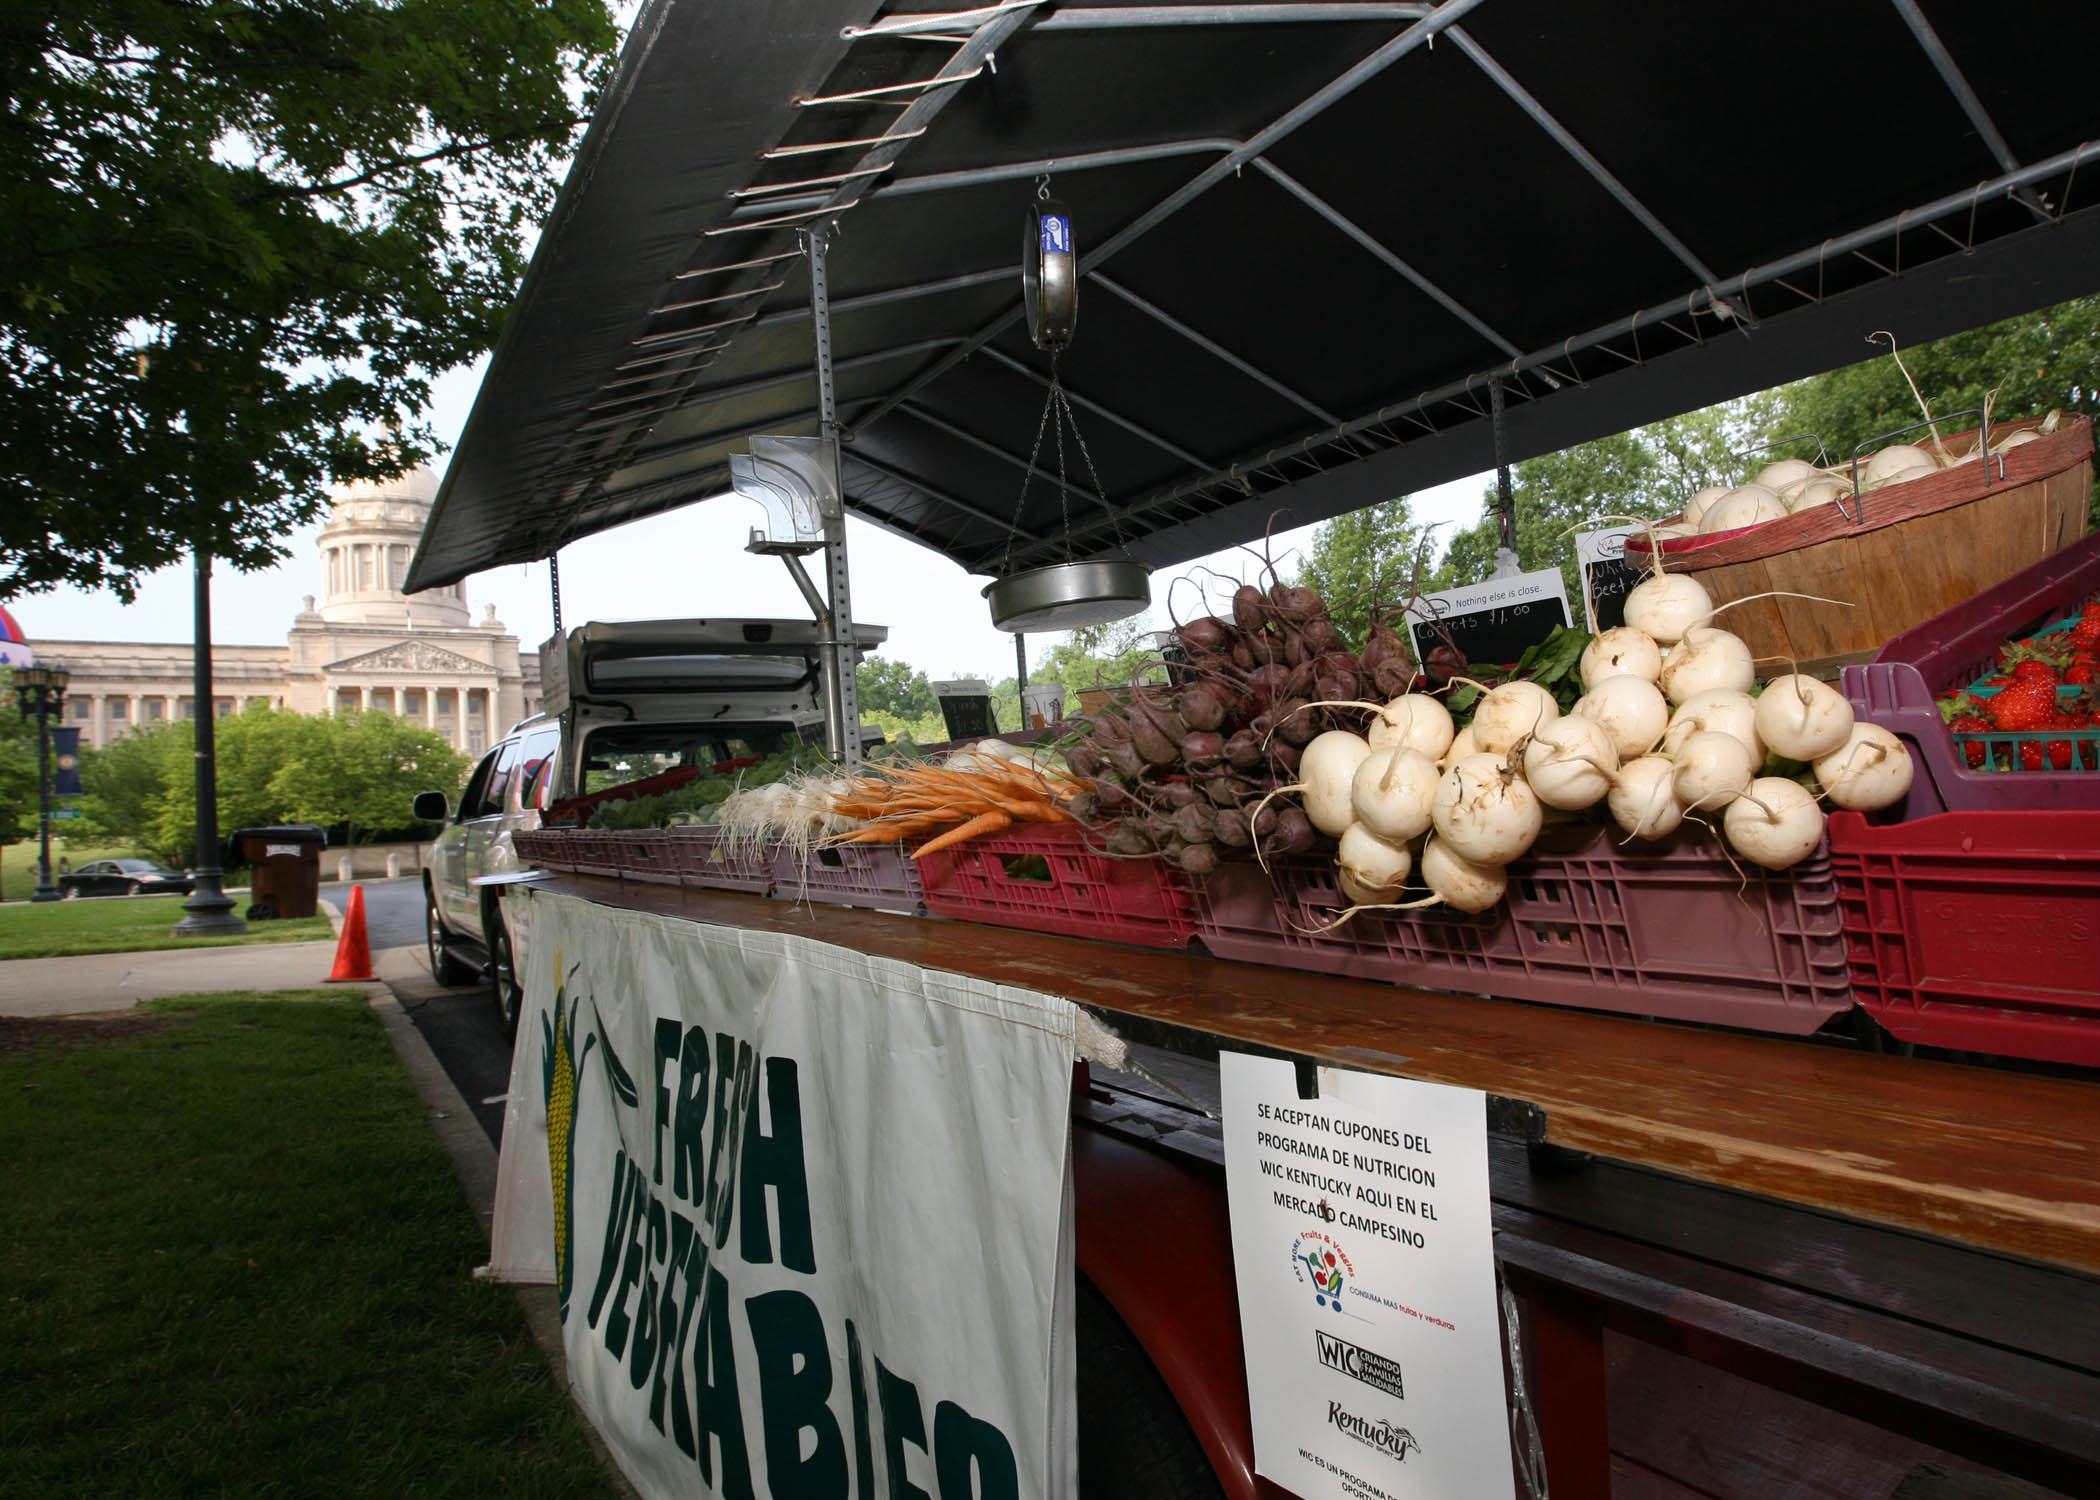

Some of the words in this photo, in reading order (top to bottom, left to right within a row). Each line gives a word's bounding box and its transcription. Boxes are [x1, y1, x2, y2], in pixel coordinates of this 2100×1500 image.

[1456, 595, 1487, 608] Nothing
[1490, 591, 1506, 601] else
[1509, 589, 1515, 598] is
[1518, 586, 1542, 597] close.
[1257, 1103, 1271, 1119] SE
[1274, 1107, 1330, 1132] ACEPTAN
[1334, 1119, 1400, 1147] CUPONES
[1404, 1133, 1432, 1154] DEL
[1257, 1131, 1329, 1162] PROGRAMA
[1333, 1149, 1350, 1168] DE
[1354, 1154, 1435, 1188] NUTRICION
[1260, 1160, 1283, 1178] WIC
[1286, 1166, 1351, 1197] KENTUCKY
[1356, 1185, 1392, 1208] AQUI
[1397, 1196, 1416, 1215] EN
[1421, 1202, 1438, 1221] EL
[1291, 1238, 1302, 1263] MORE
[1300, 1230, 1322, 1241] Fruits
[1324, 1235, 1331, 1244] &
[1340, 1211, 1424, 1249] CAMPESINO
[1349, 1286, 1382, 1305] CONSUMA
[1381, 1298, 1398, 1310] MAS
[1425, 1314, 1456, 1331] verduras
[1319, 1334, 1359, 1377] WIC
[1360, 1351, 1400, 1375] CRIANDO
[1363, 1362, 1402, 1386] FAMILIAS
[1361, 1372, 1403, 1397] SALUDABLES
[1328, 1400, 1407, 1462] Kentucky
[1298, 1447, 1313, 1462] WIC
[1314, 1456, 1325, 1468] ES
[1327, 1462, 1338, 1475] UN
[1340, 1469, 1387, 1500] PROGRAMA
